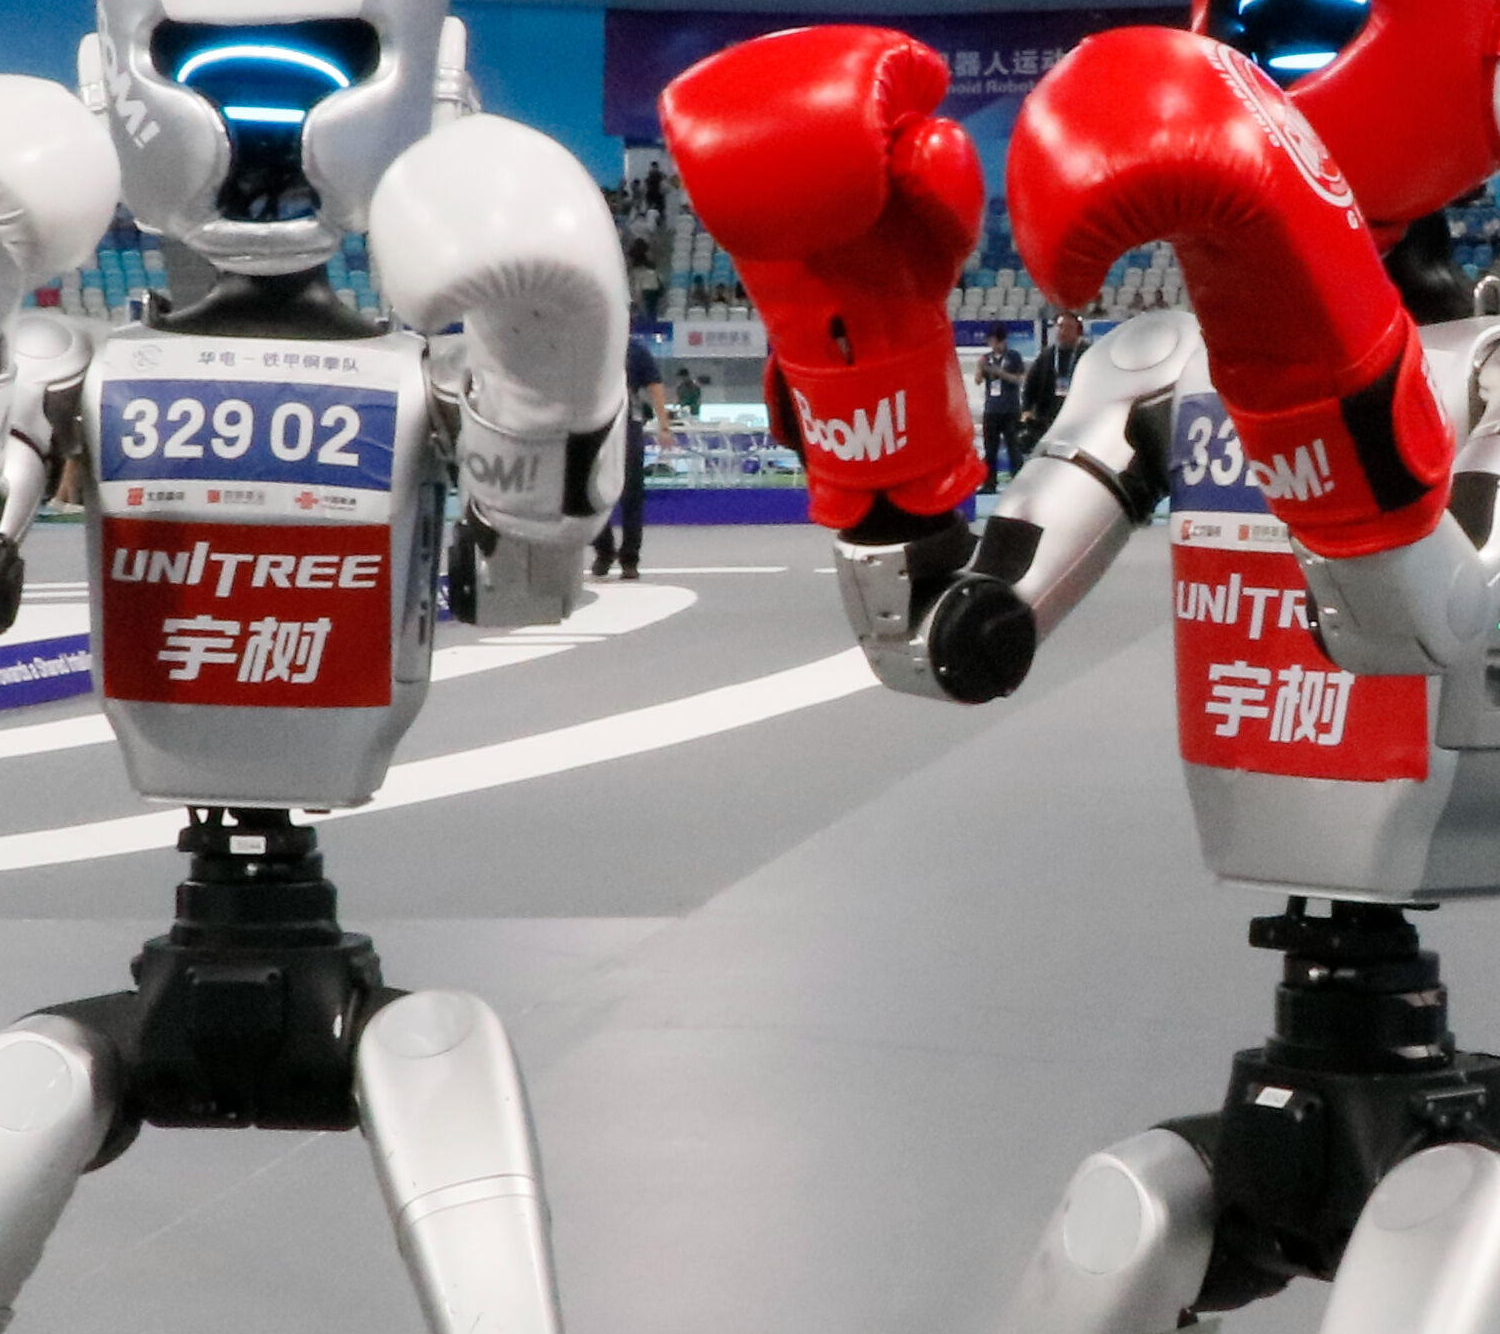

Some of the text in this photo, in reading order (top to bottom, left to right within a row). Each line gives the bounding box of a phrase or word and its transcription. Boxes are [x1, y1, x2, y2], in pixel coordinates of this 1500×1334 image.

[121, 398, 361, 467] 329 02
[792, 387, 908, 462] BOOM!
[1183, 416, 1261, 487] 33
[111, 541, 382, 598] UNITREE
[157, 615, 333, 684] 宇树
[1205, 660, 1356, 746] 宇树
